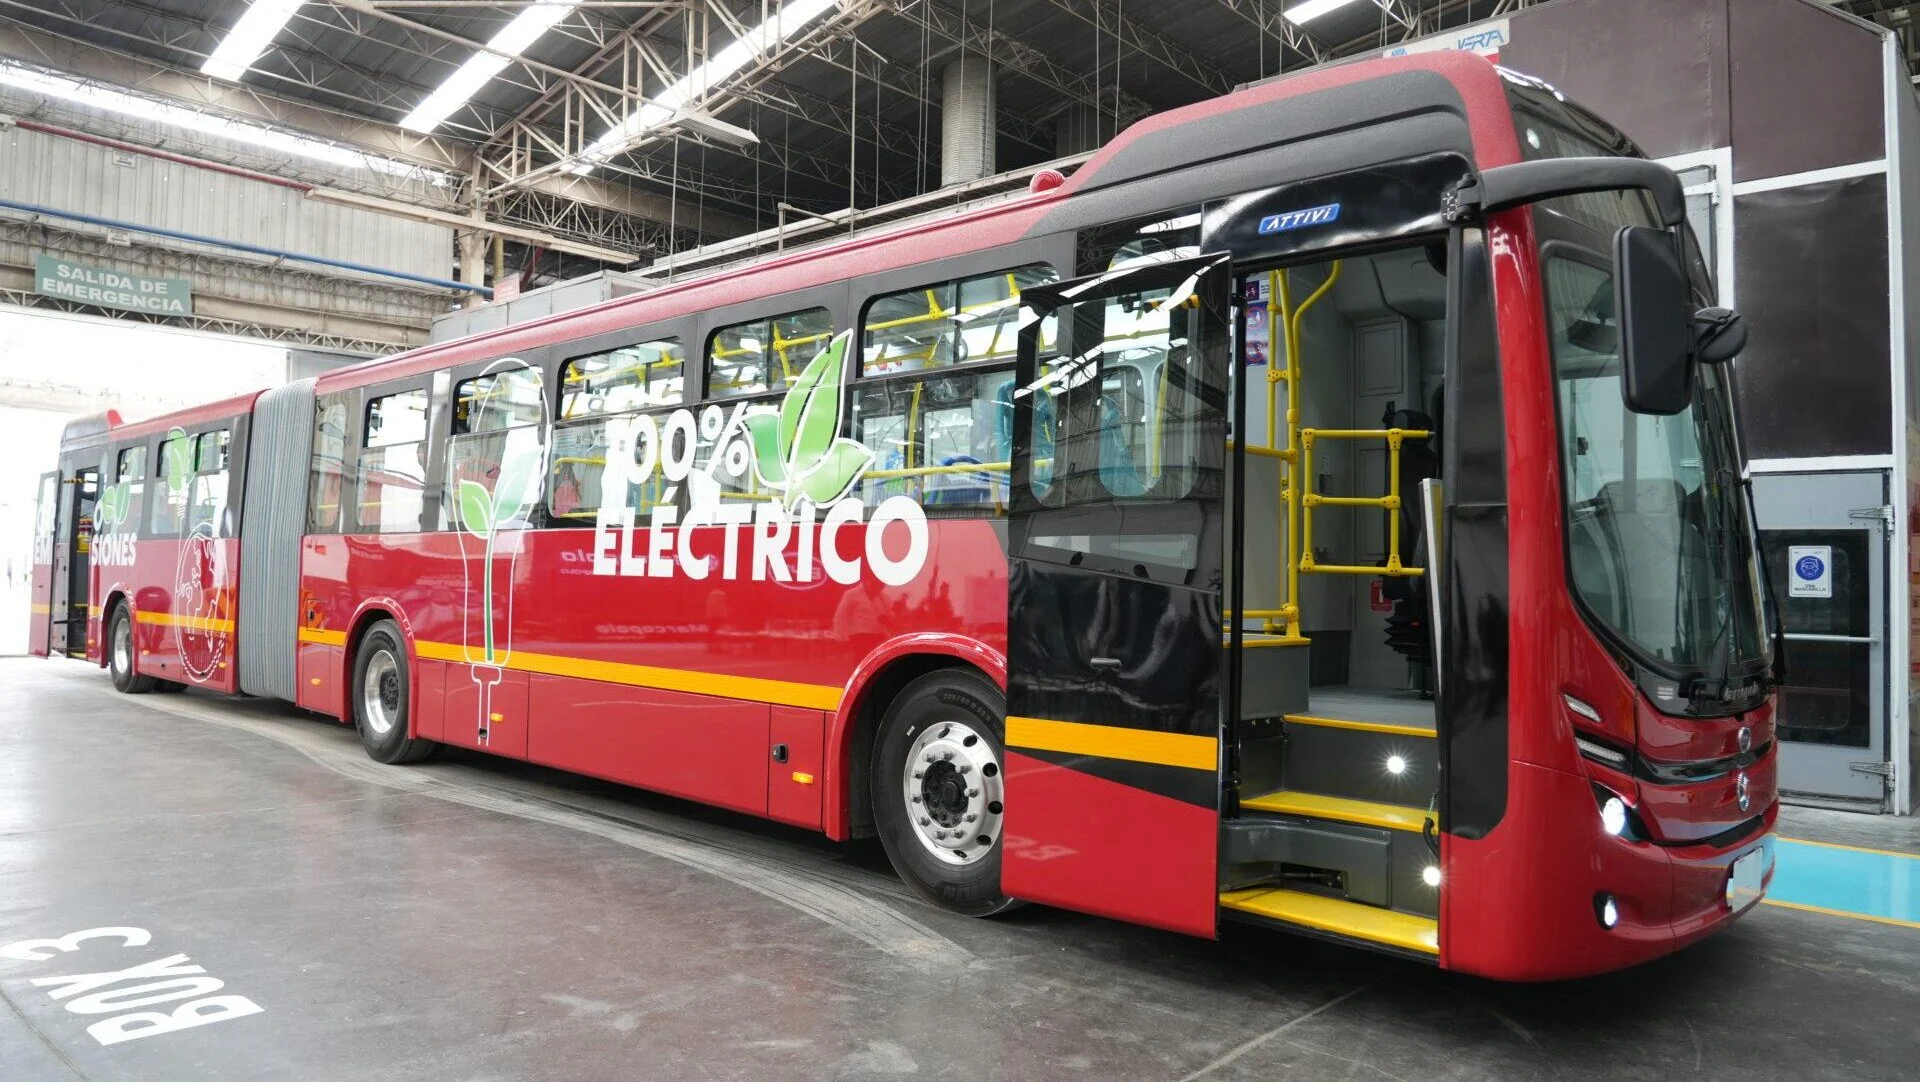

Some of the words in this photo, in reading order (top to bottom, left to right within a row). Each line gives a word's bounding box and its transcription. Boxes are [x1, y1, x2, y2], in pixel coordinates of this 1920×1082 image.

[1457, 29, 1504, 51] VERTA
[42, 277, 184, 312] EMERGENCIA
[57, 263, 134, 291] SALIDA
[140, 279, 168, 294] DE
[592, 486, 930, 587] ELÉCTRICO
[0, 926, 152, 962] 3
[30, 953, 265, 1047] BOX
